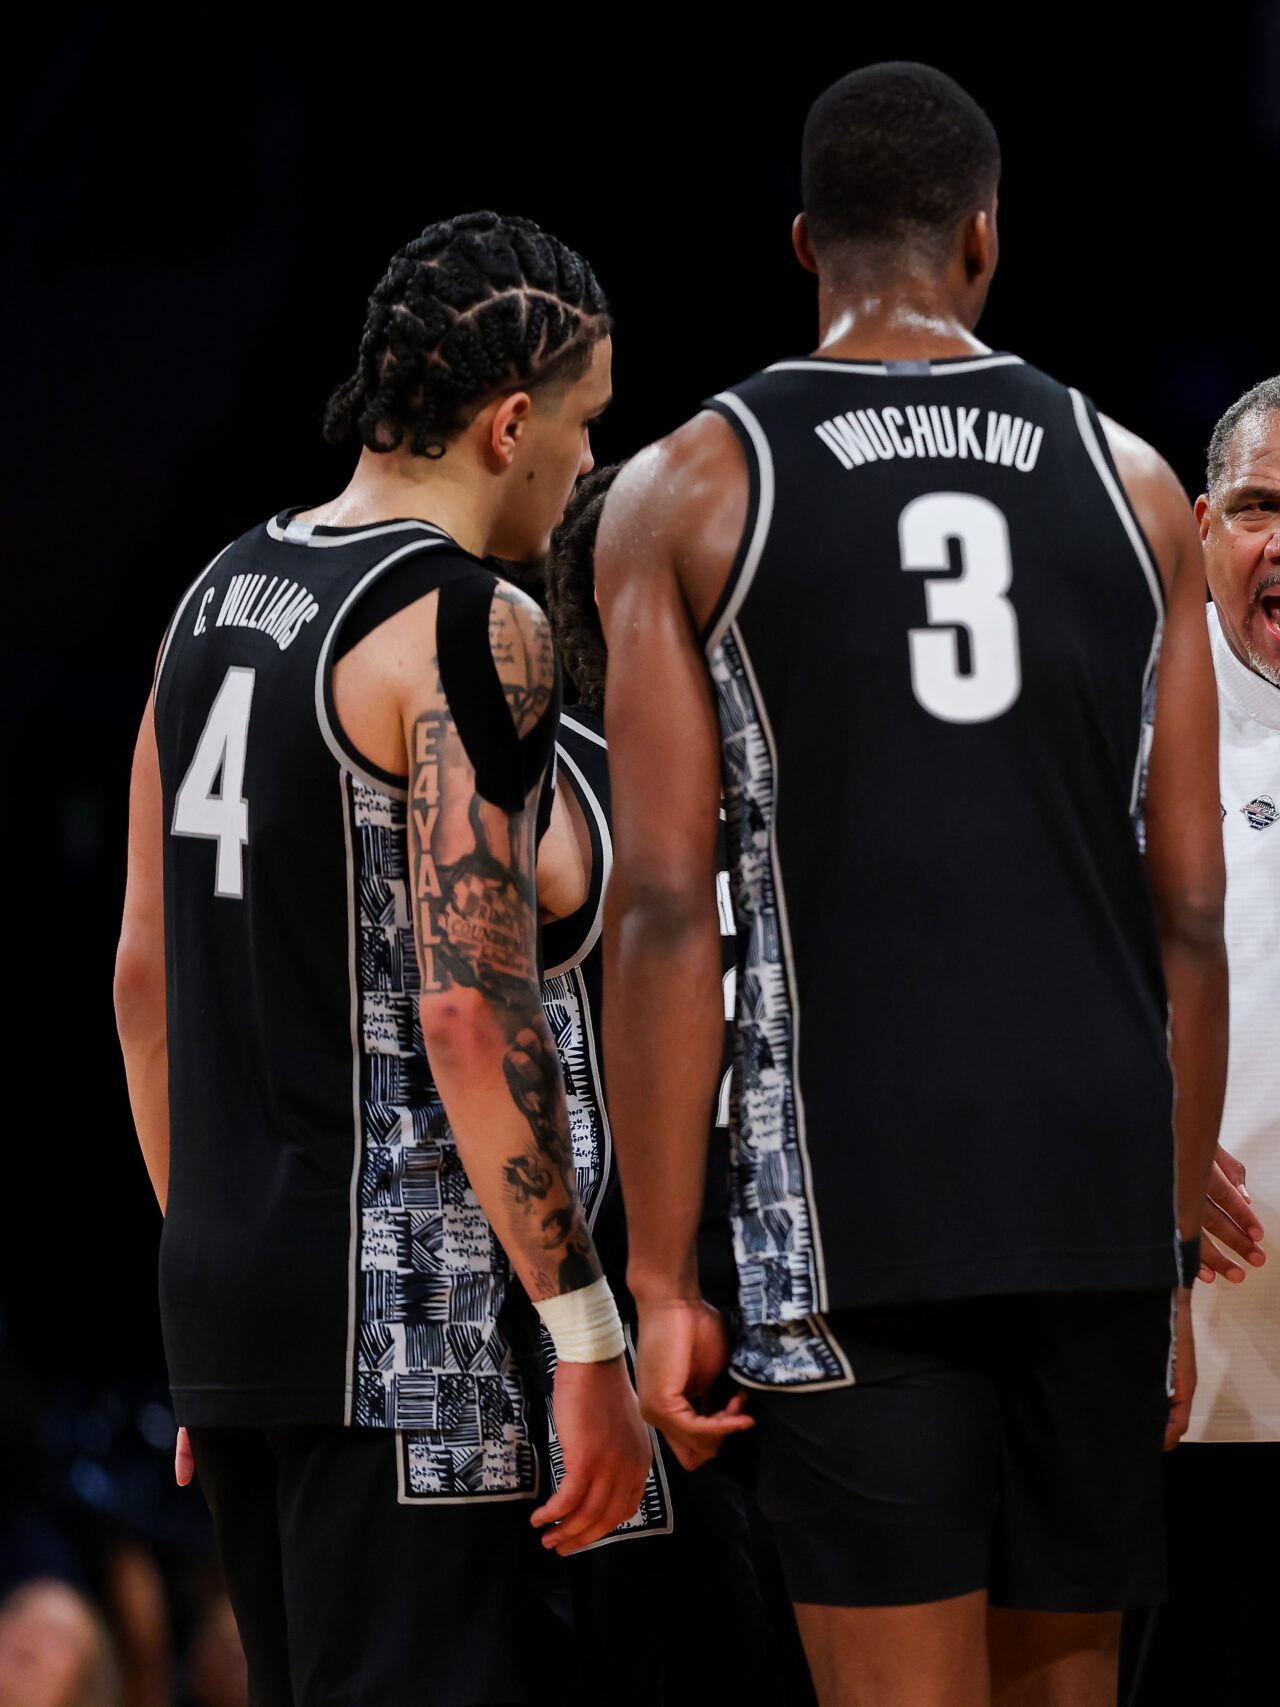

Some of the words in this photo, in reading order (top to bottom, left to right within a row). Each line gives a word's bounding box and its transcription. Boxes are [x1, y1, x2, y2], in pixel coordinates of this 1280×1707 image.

[814, 405, 1044, 473] IWUCHUKWU
[193, 586, 216, 637] C.
[215, 573, 320, 651] WILLIAMS
[897, 491, 1021, 724] 3
[170, 665, 256, 899] 4
